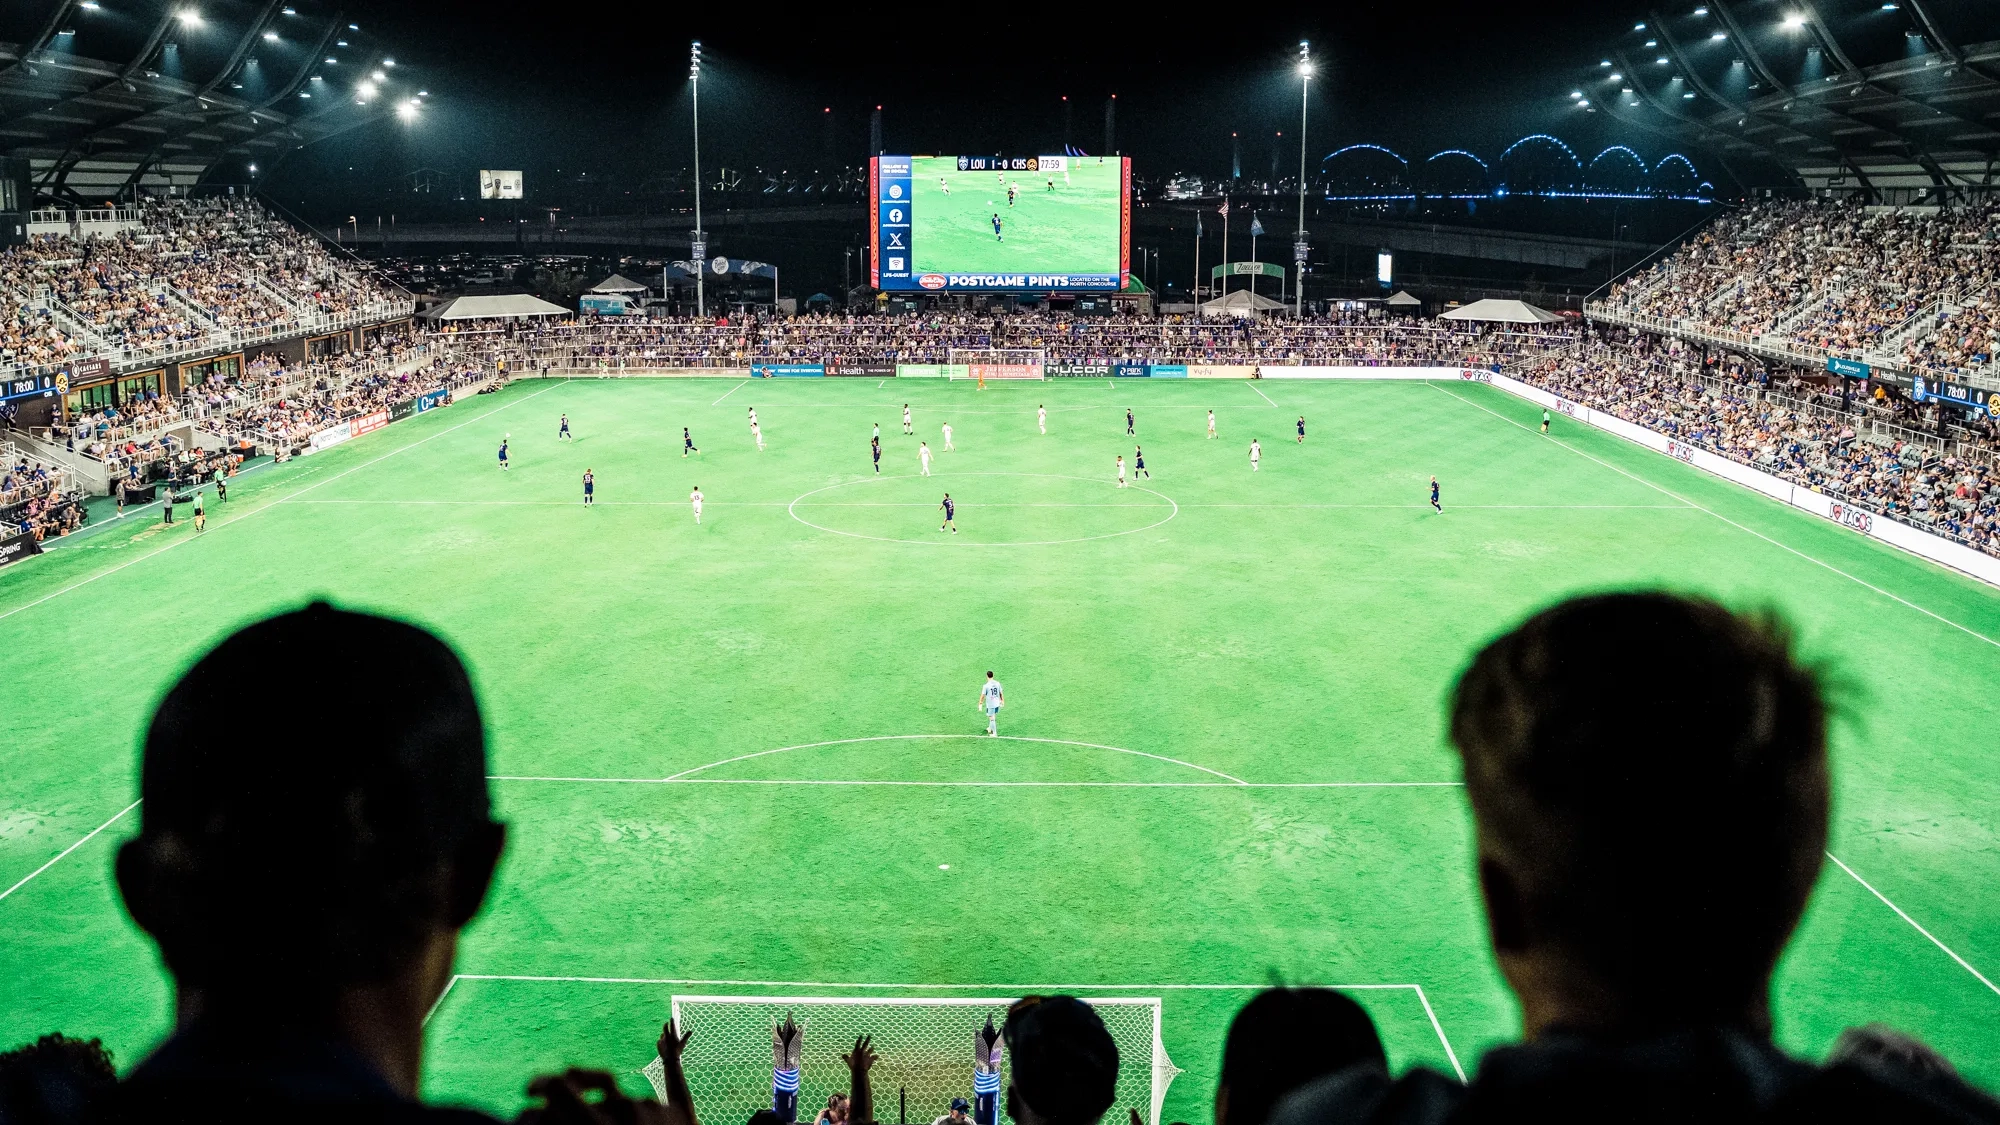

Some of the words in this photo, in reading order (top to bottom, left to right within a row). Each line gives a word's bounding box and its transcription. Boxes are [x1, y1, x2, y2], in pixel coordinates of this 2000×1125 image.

[970, 159, 986, 169] LOU
[1011, 159, 1027, 169] CHS
[1040, 160, 1060, 169] 77:59
[949, 275, 1025, 287] POSTGAME
[1029, 275, 1069, 287] PINTS
[79, 363, 102, 373] CAESARS
[825, 364, 838, 375] UL
[839, 364, 865, 375] Health
[1047, 365, 1110, 374] NUCOR
[14, 380, 34, 394] 78:00
[44, 376, 50, 389] 0
[1947, 385, 1967, 400] 78:00
[1976, 391, 1983, 404] 0
[1842, 504, 1873, 533] TACOS
[990, 687, 998, 696] 18
